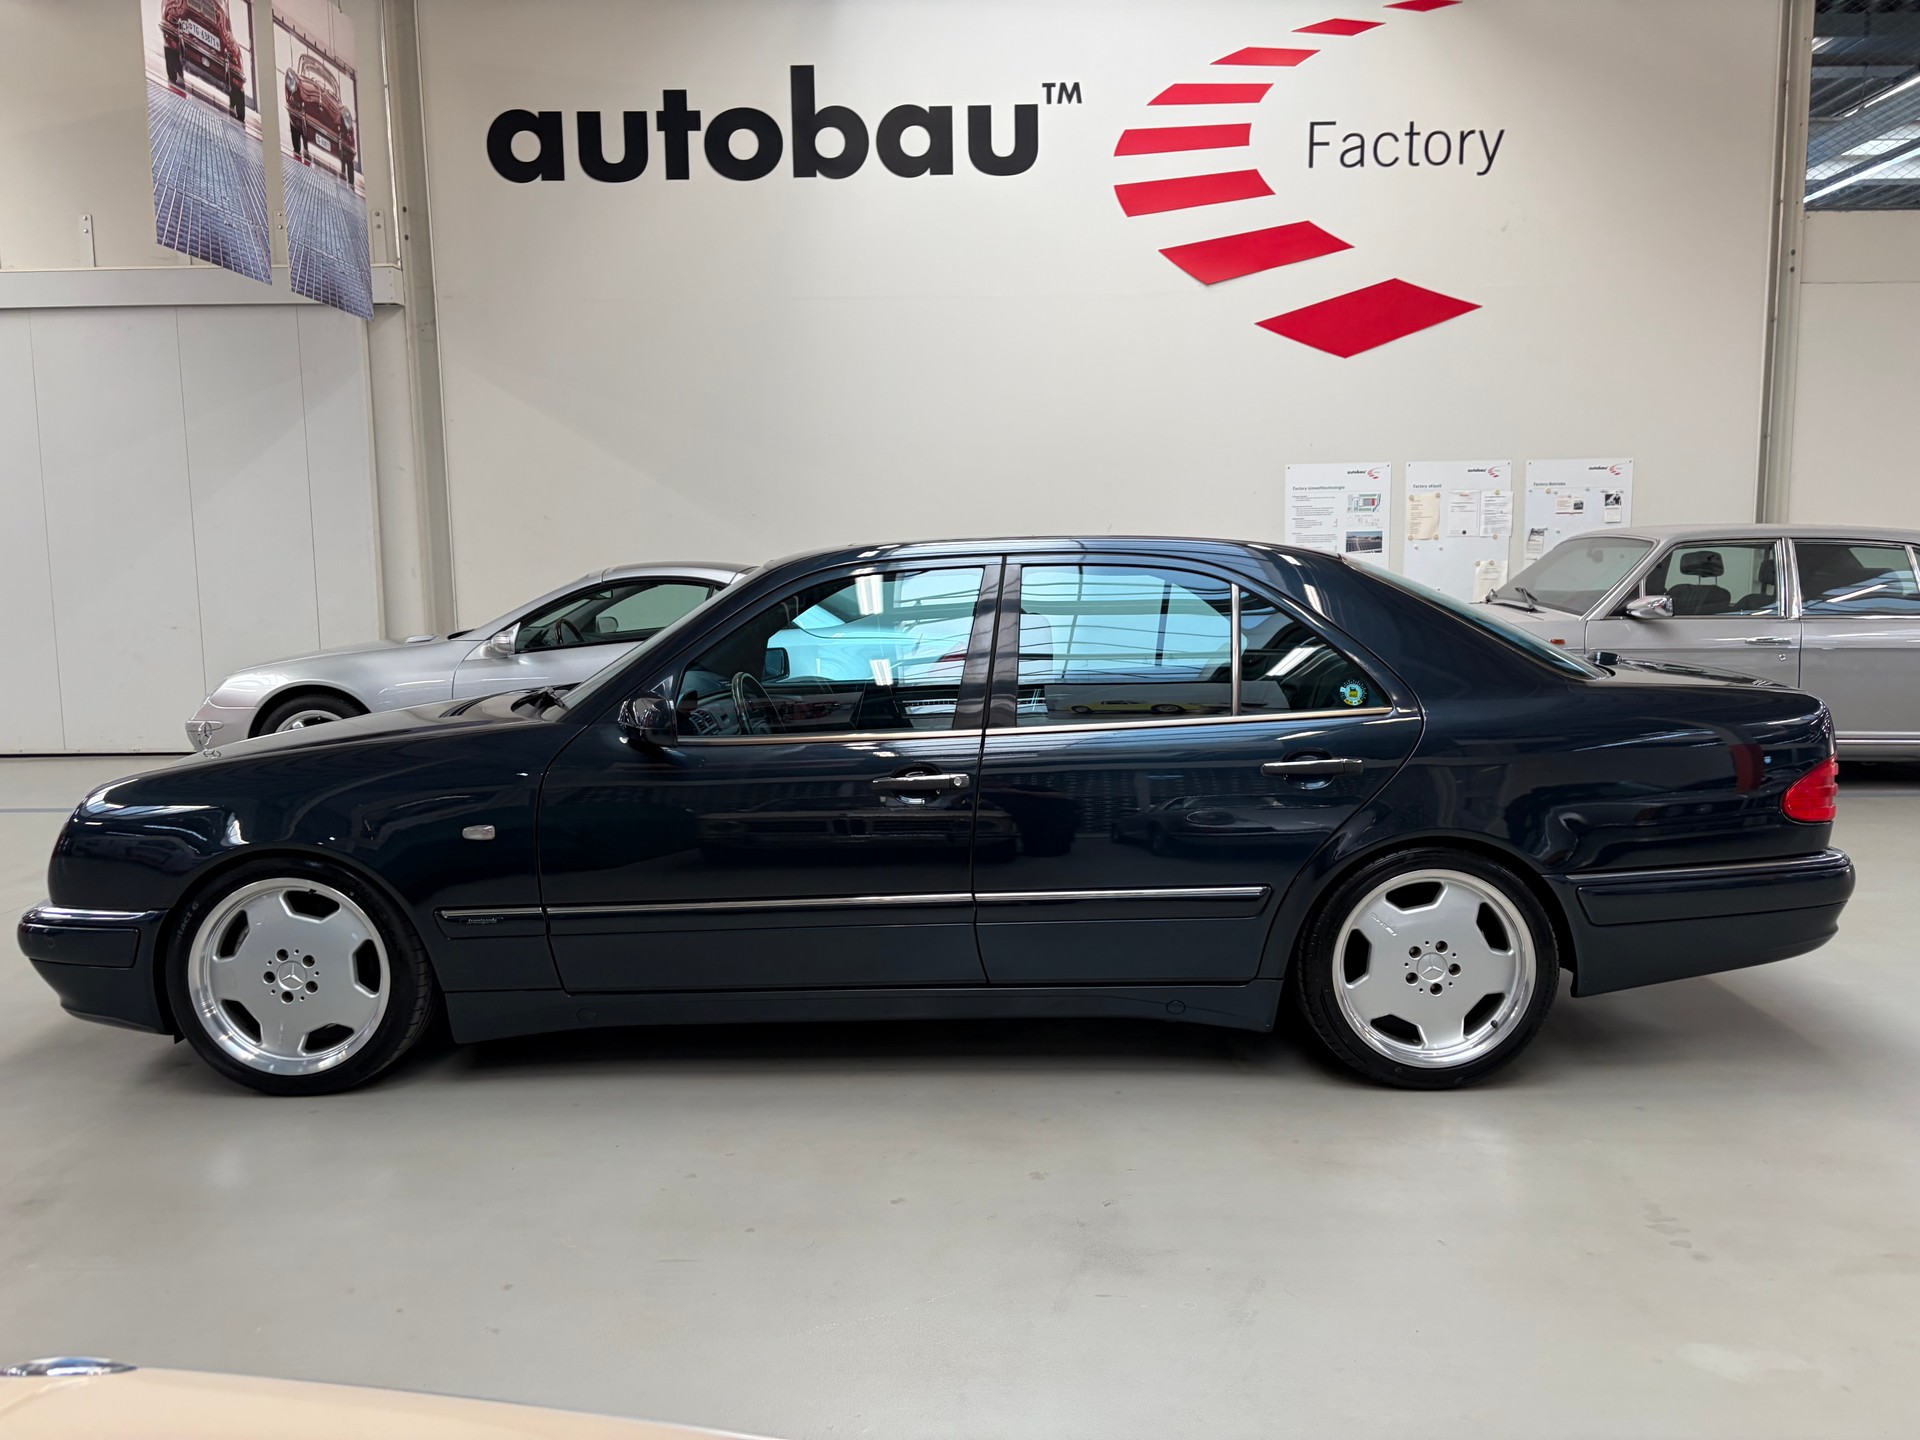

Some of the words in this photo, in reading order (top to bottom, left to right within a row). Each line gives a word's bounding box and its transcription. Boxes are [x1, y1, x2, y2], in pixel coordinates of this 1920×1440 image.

[487, 65, 1039, 183] autobau
[1042, 82, 1083, 104] TM
[1308, 121, 1505, 176] Factory
